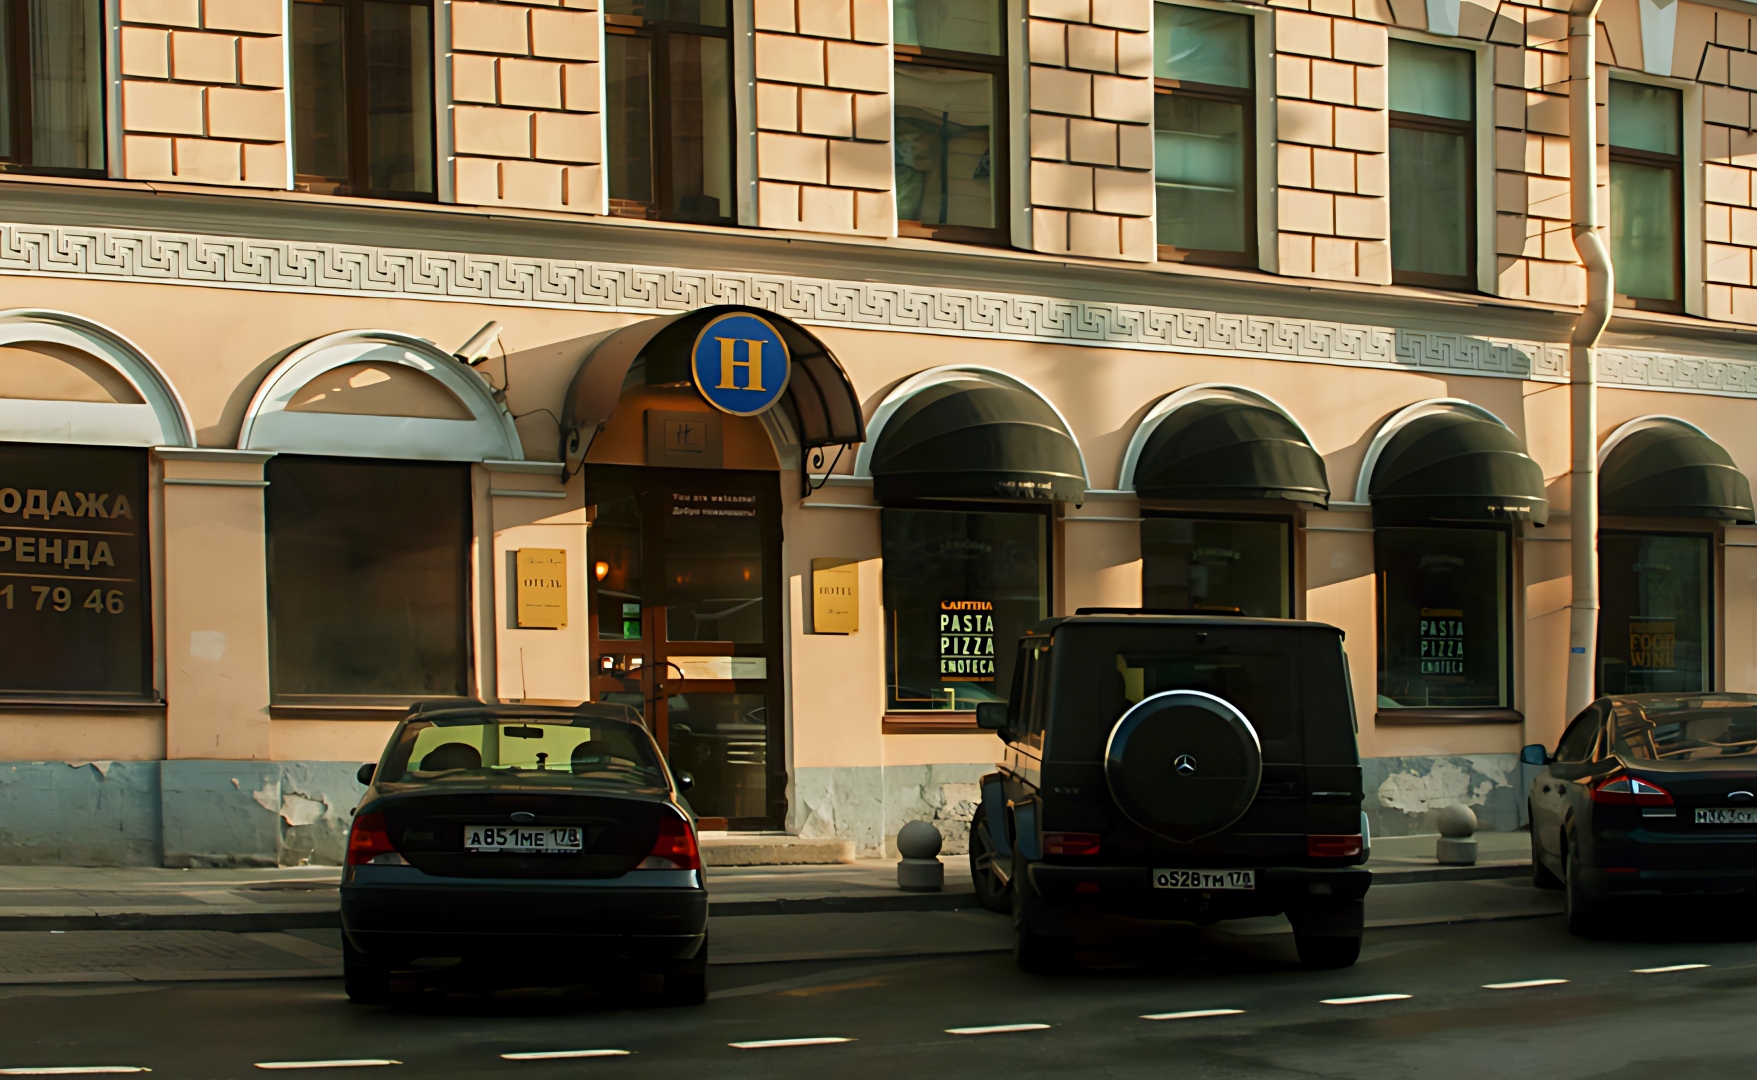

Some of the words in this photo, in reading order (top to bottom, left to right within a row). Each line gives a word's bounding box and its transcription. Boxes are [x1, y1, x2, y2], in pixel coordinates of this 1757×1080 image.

[714, 336, 768, 392] H
[0, 487, 133, 520] ОДАЖА
[30, 585, 72, 612] 79
[83, 588, 125, 615] 46
[940, 614, 994, 632] PASTA
[1420, 620, 1463, 636] PASTA
[940, 637, 995, 654] PIZZA
[1421, 641, 1463, 657] PIZZA
[940, 659, 995, 673] ENOTECA
